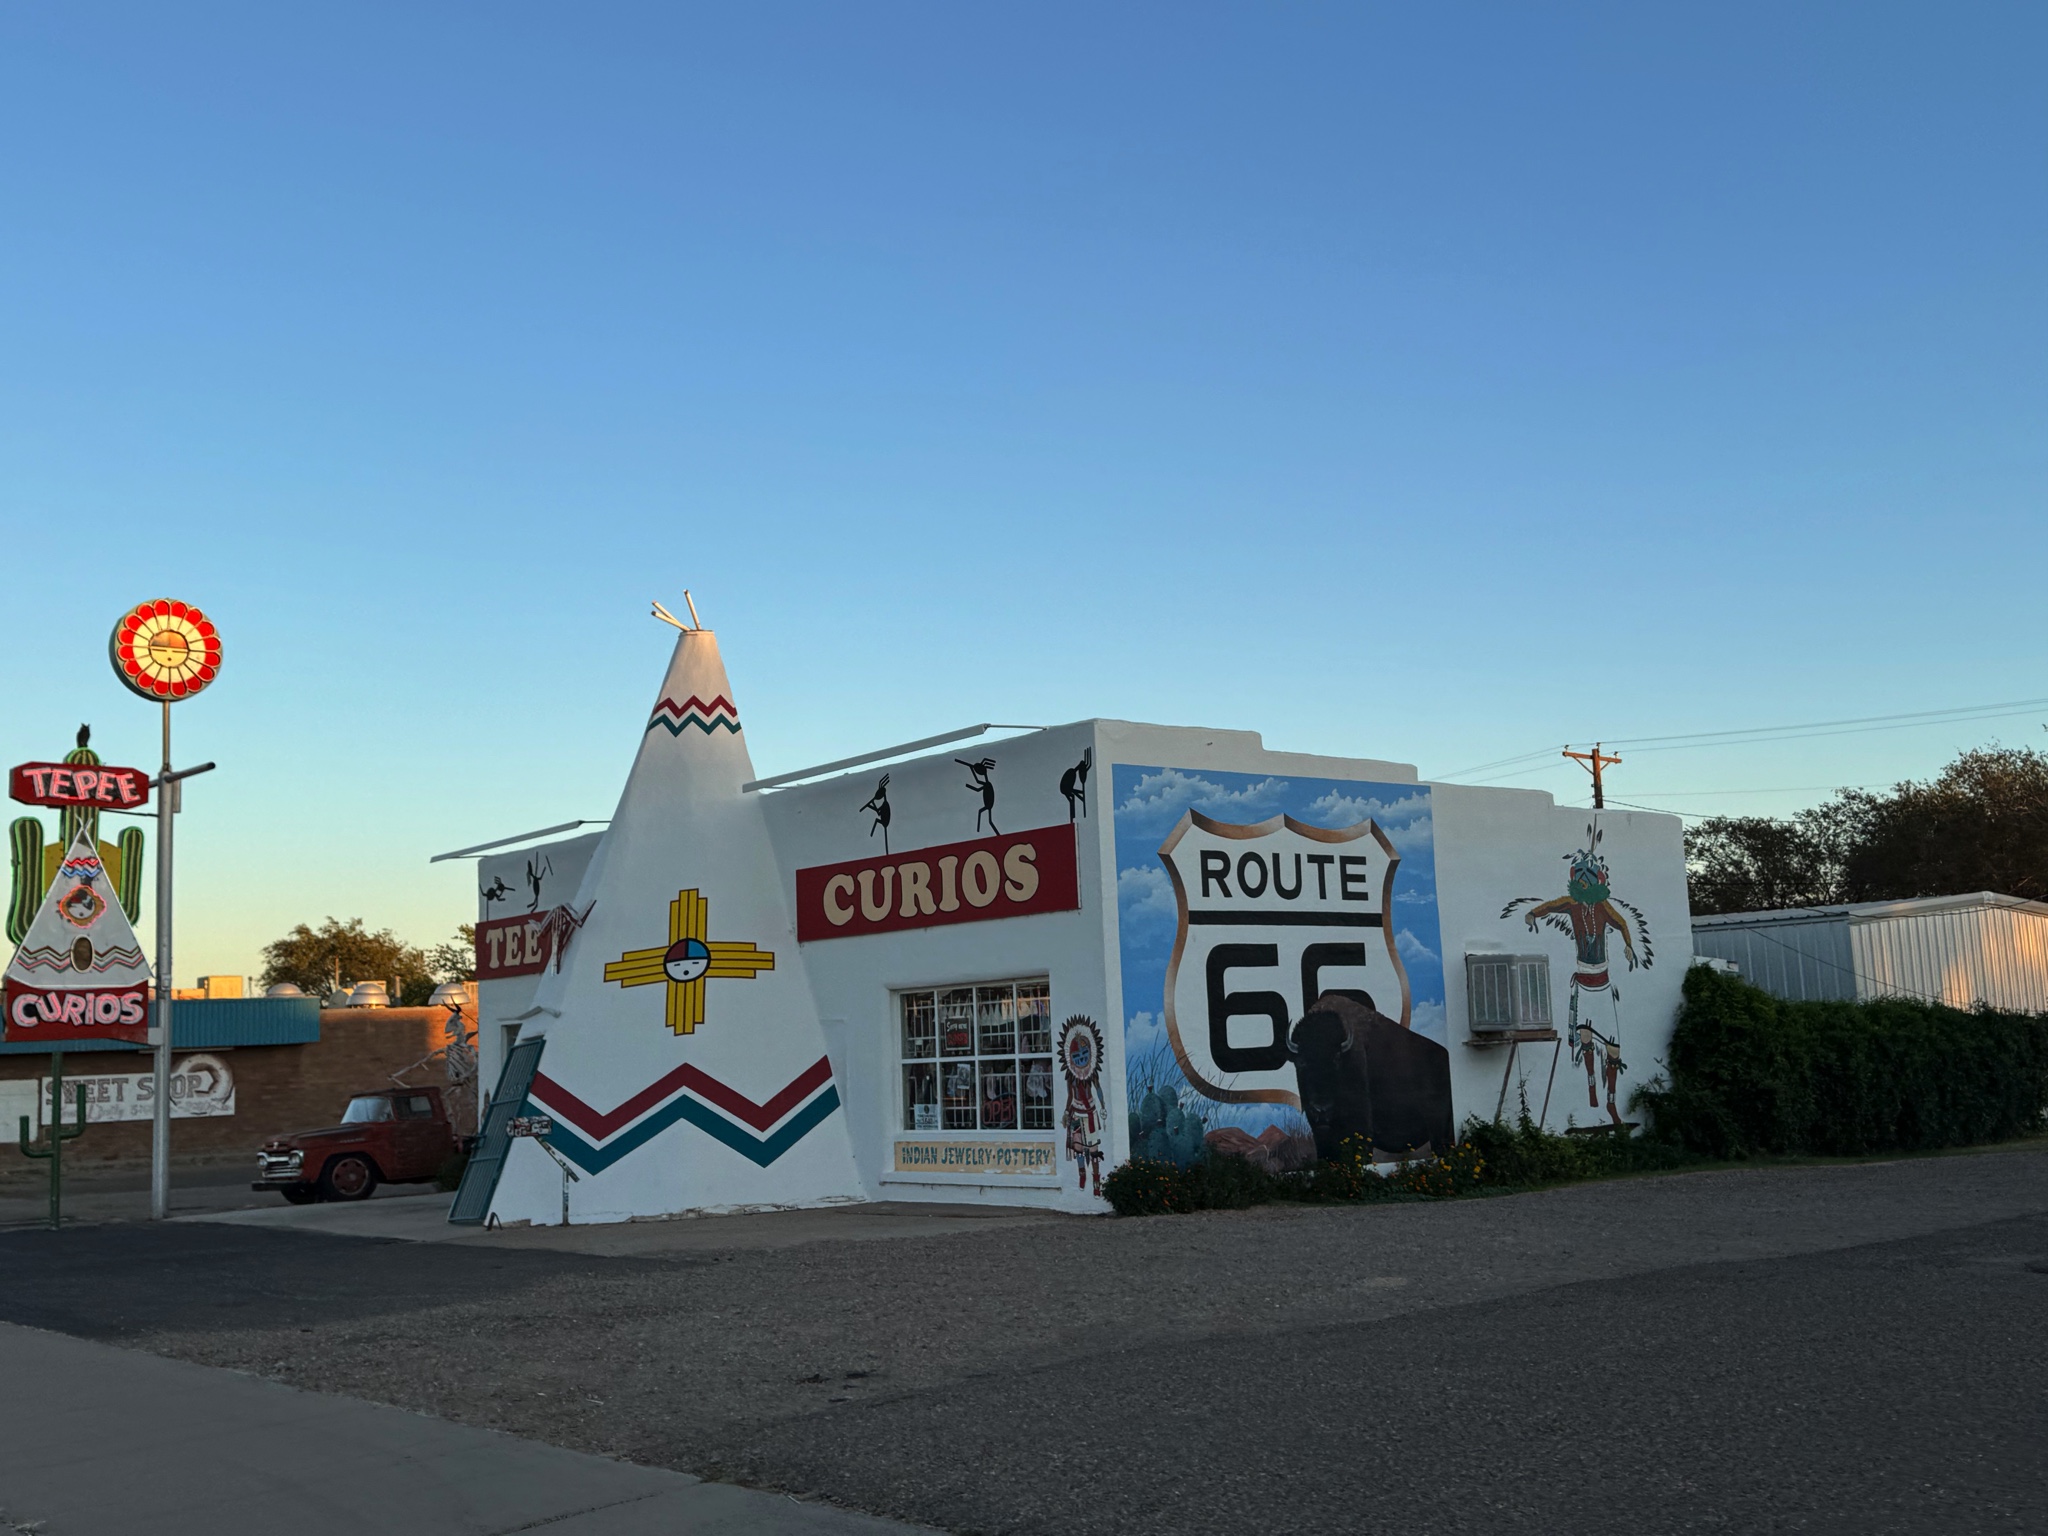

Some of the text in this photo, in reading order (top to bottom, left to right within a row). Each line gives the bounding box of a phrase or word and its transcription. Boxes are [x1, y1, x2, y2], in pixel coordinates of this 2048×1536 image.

[22, 767, 141, 804] TEPEE
[823, 843, 1039, 926] CURIOS
[1200, 850, 1369, 901] ROUTE
[486, 924, 542, 969] TEE
[11, 992, 144, 1028] CURIOS
[1206, 942, 1376, 1073] 66
[137, 1074, 202, 1101] SOP
[902, 1147, 937, 1164] INDIAN
